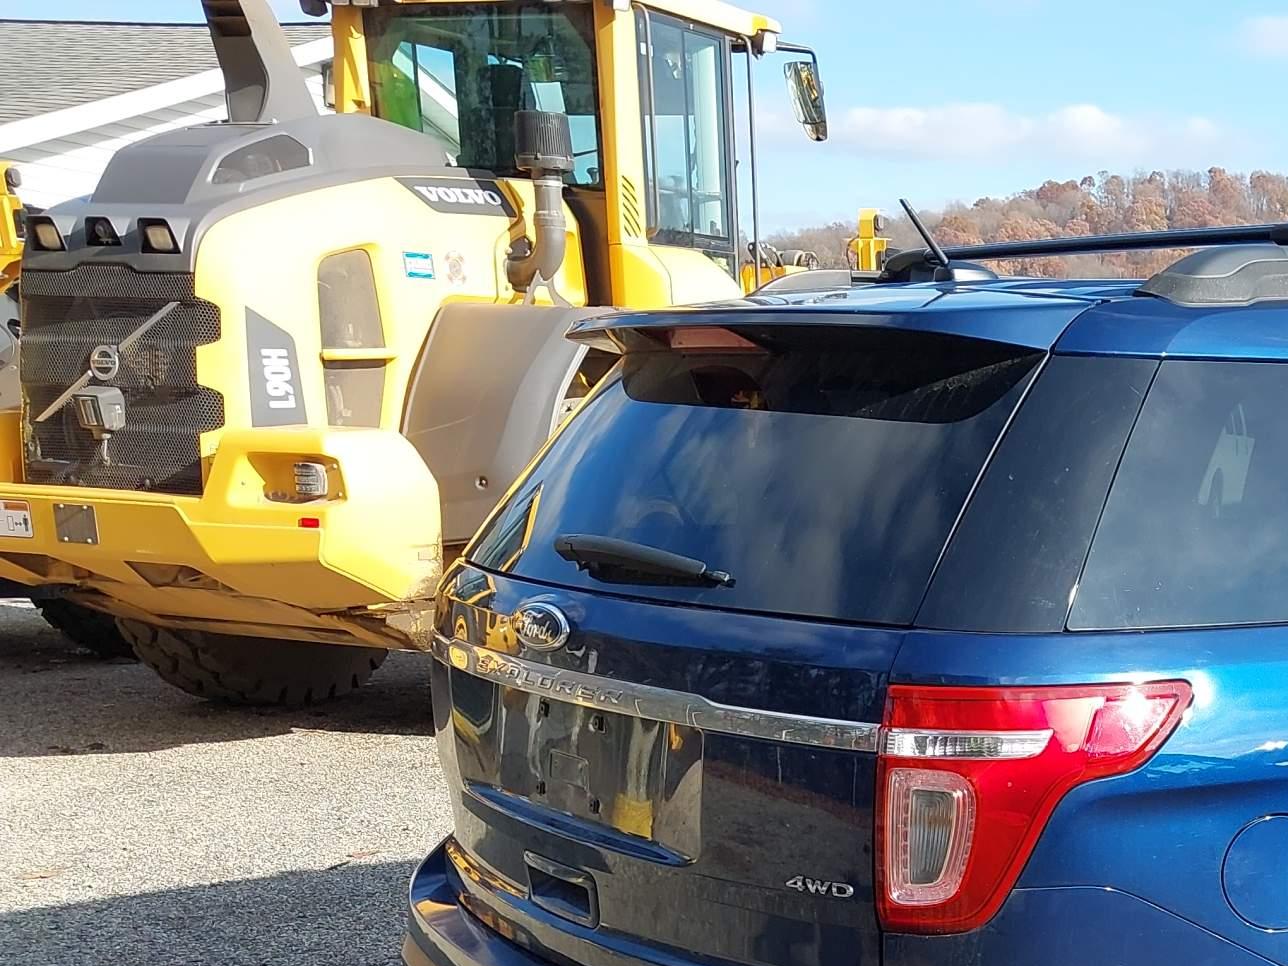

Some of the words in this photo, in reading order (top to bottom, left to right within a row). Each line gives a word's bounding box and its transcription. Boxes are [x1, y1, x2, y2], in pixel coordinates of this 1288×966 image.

[413, 185, 502, 206] VOLVO
[260, 348, 297, 409] L90H
[520, 609, 553, 642] Ford
[477, 654, 624, 704] EXPLORER
[785, 875, 854, 898] 4WD
